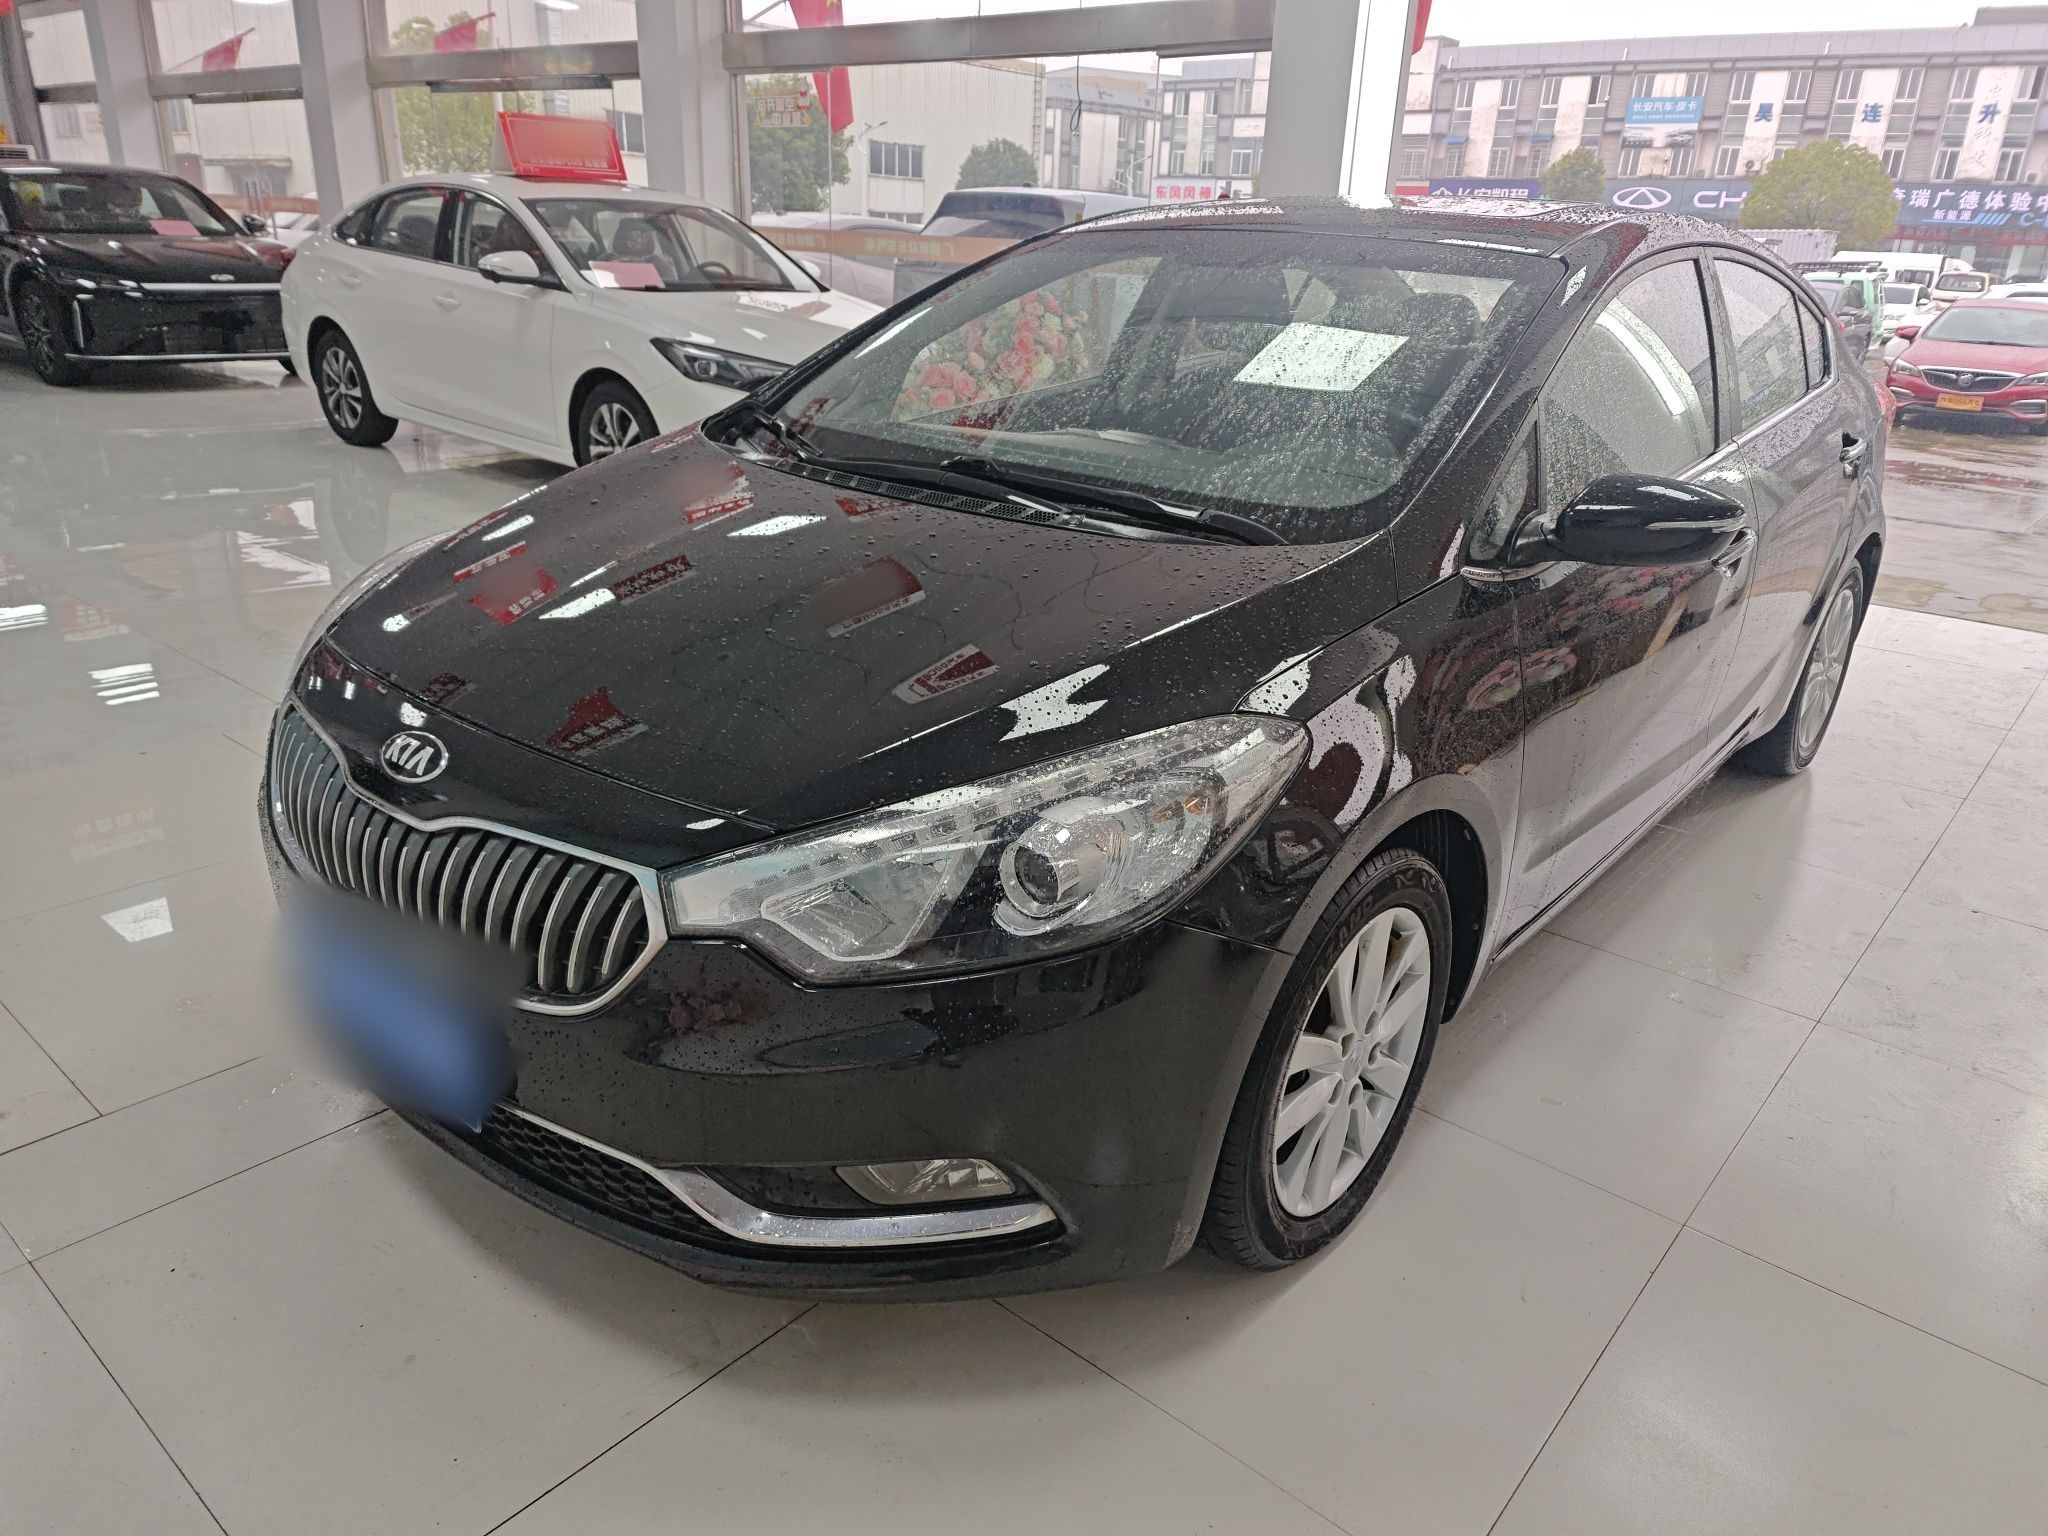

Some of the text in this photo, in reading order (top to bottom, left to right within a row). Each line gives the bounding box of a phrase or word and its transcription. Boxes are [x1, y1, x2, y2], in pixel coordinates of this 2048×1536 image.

[1155, 184, 1212, 200] 东风风神
[1933, 209, 1972, 221] 新能源
[385, 734, 435, 776] KIA
